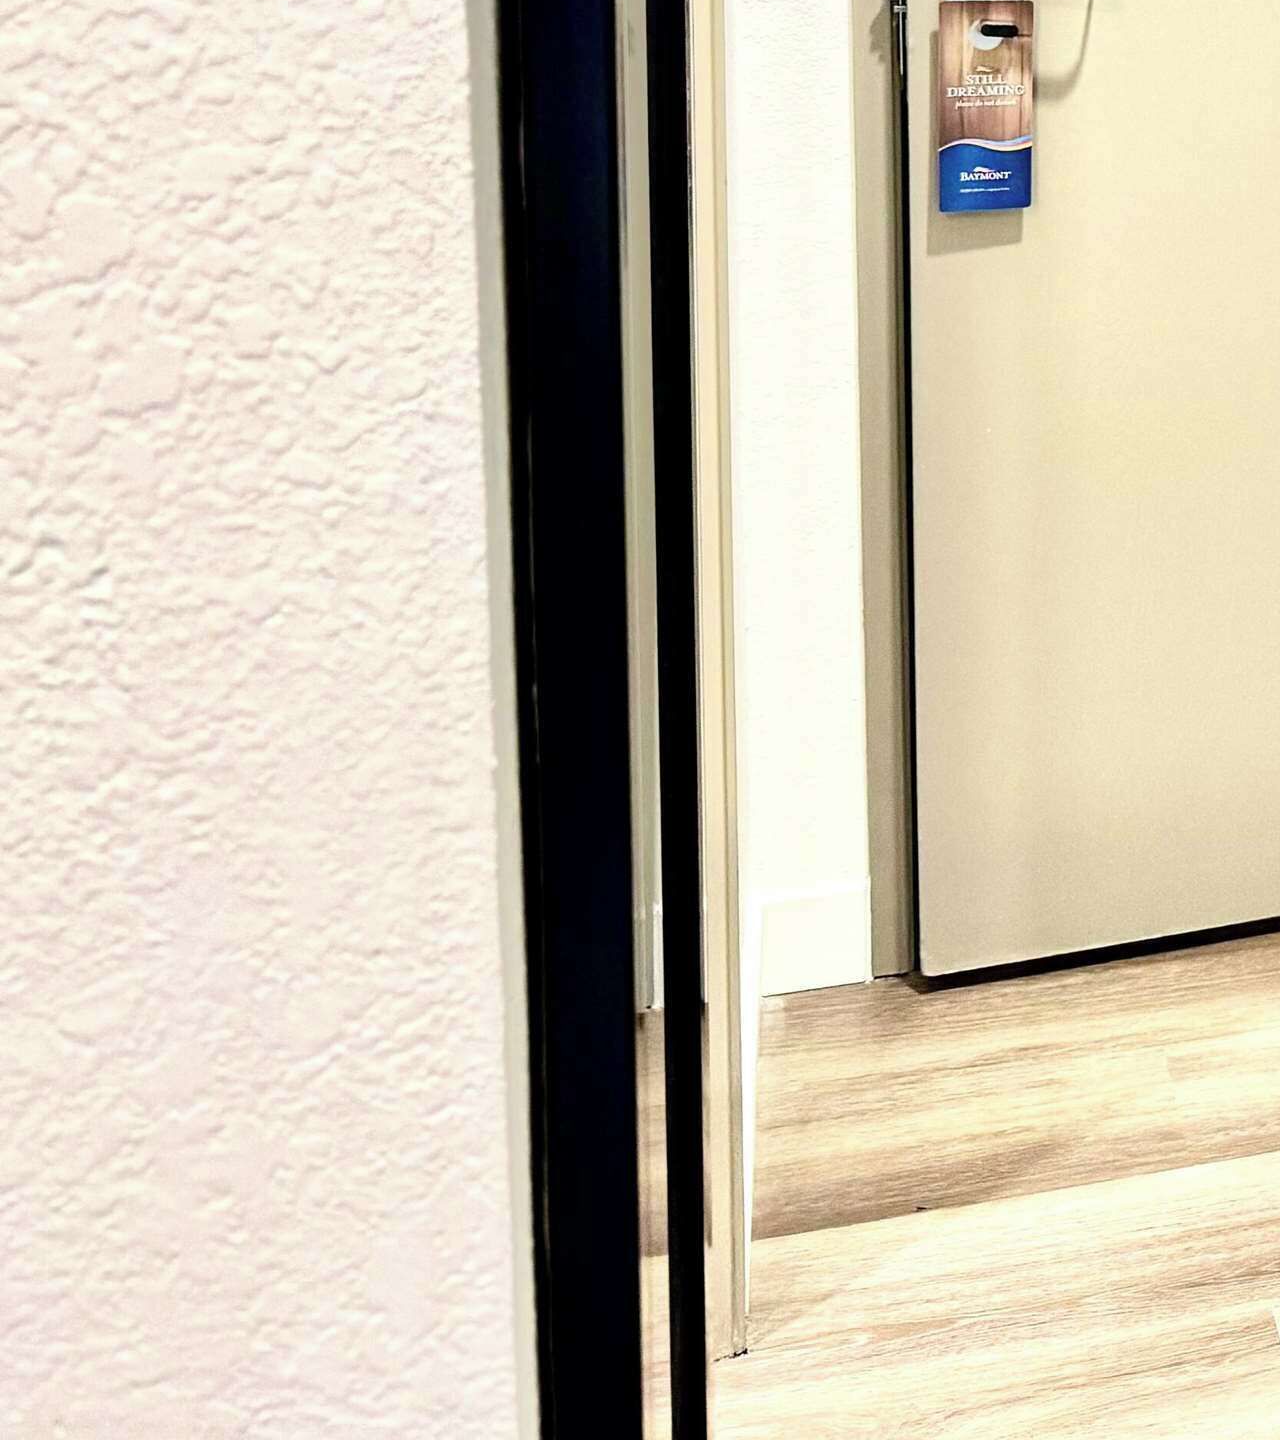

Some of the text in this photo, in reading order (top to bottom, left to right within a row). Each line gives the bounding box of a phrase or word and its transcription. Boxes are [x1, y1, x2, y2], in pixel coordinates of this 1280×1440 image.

[966, 74, 1007, 85] STILL
[946, 85, 1026, 97] DREAMING
[960, 170, 1011, 182] BAYMONT
